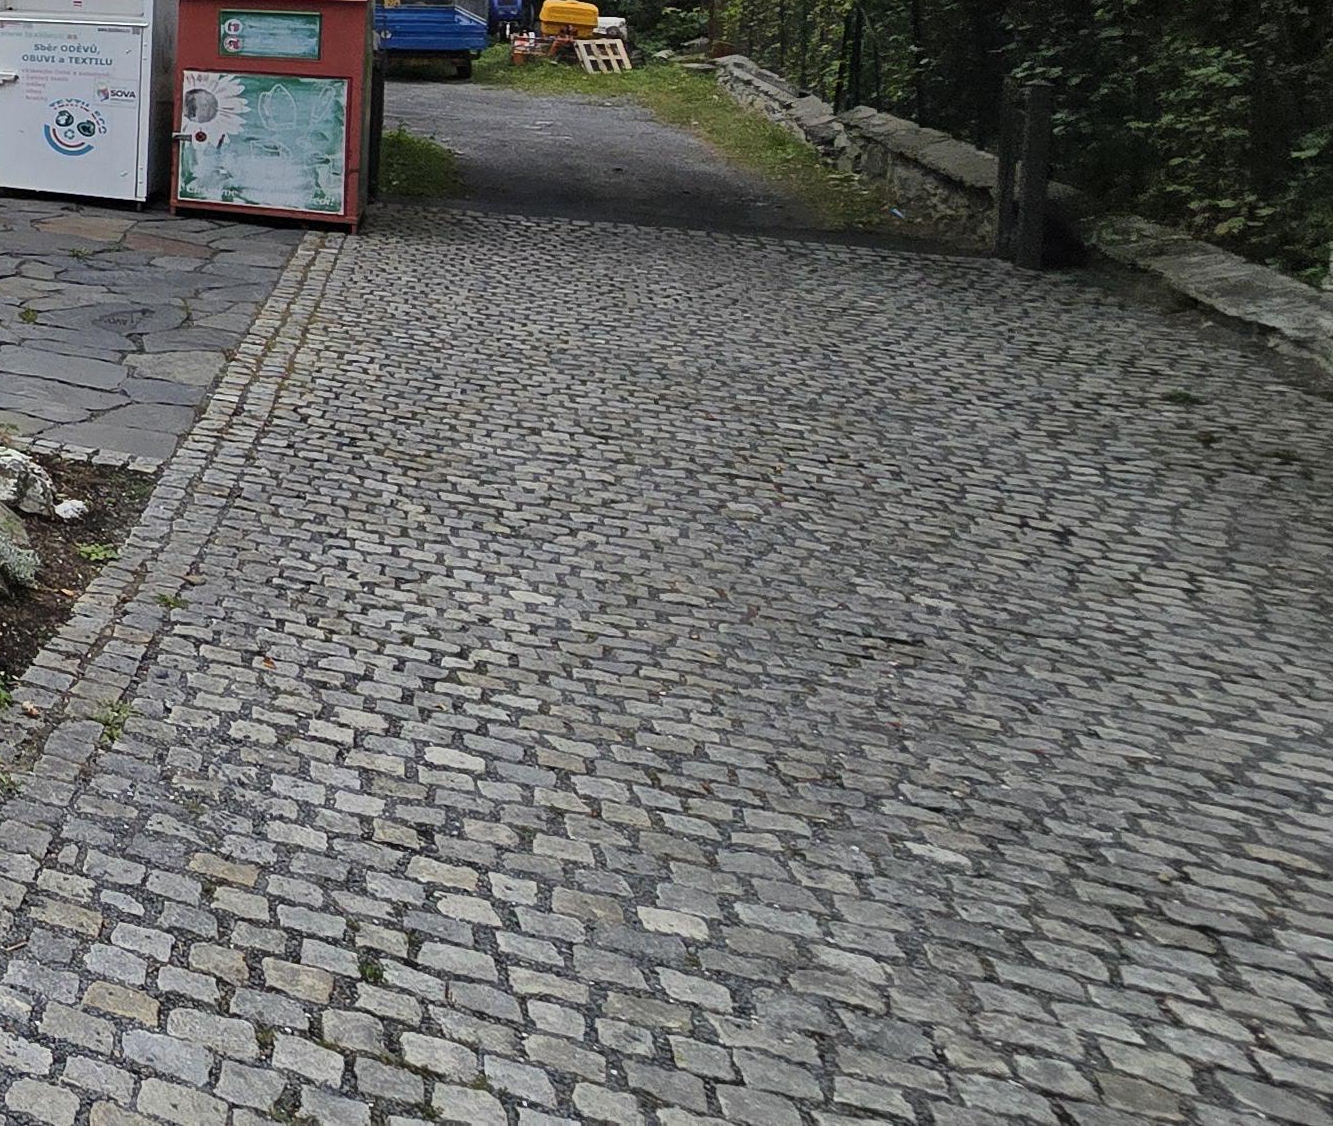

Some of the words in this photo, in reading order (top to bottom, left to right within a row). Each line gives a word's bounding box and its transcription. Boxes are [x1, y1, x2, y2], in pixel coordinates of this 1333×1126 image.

[34, 43, 58, 52] Sběr
[21, 54, 55, 63] OBUVI
[68, 56, 113, 65] TEXTILU
[110, 89, 136, 98] SOVA
